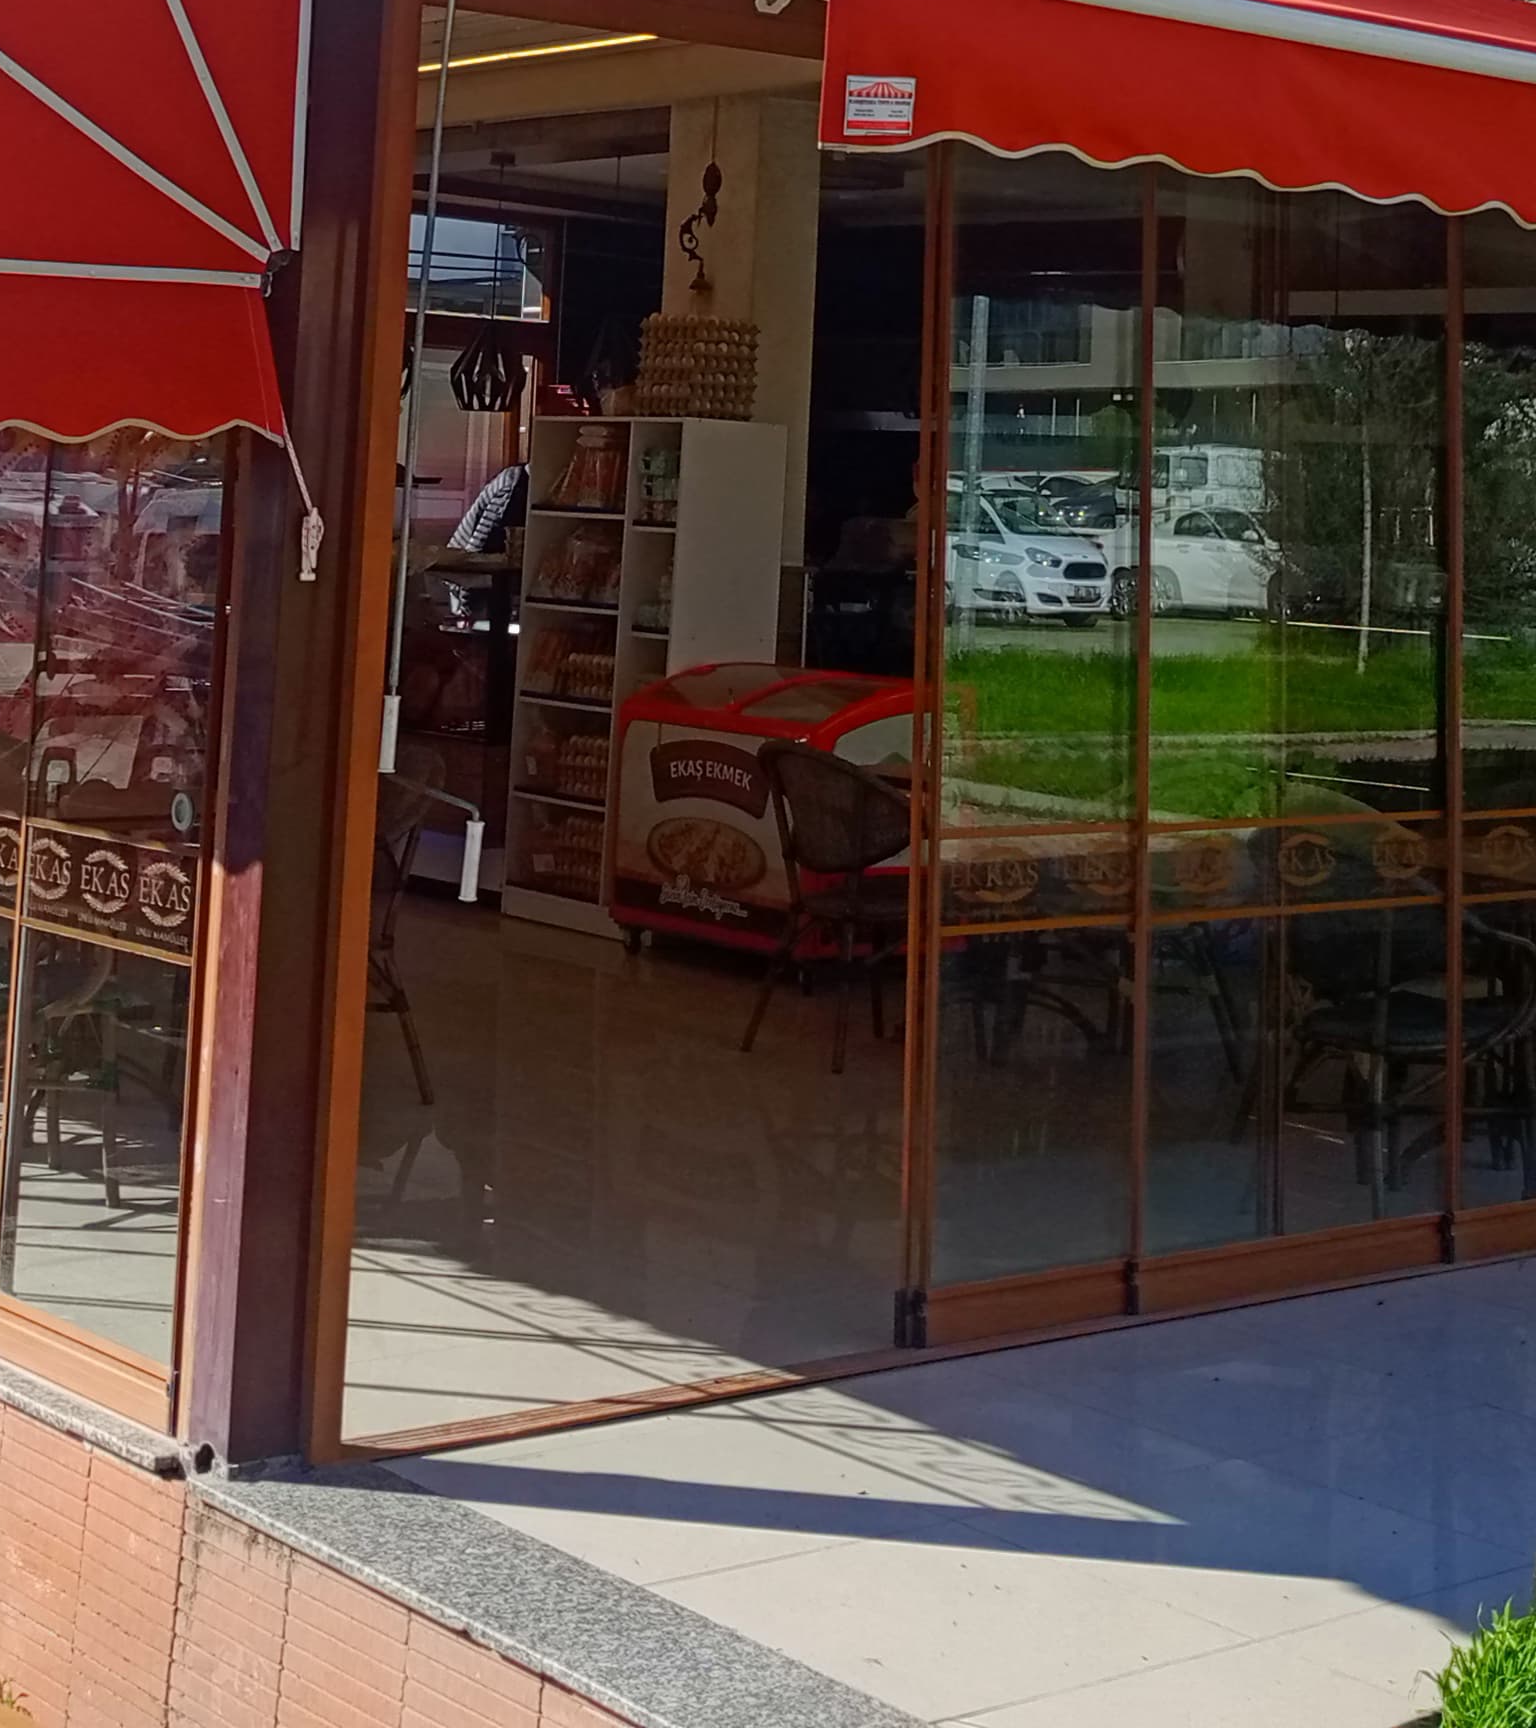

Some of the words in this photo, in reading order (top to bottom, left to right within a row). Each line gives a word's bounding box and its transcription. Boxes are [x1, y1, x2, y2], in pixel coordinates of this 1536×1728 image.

[670, 760, 703, 781] EKAŞ
[705, 761, 753, 792] EKMEK
[80, 864, 130, 899] EKAS
[138, 876, 192, 912] EKAS
